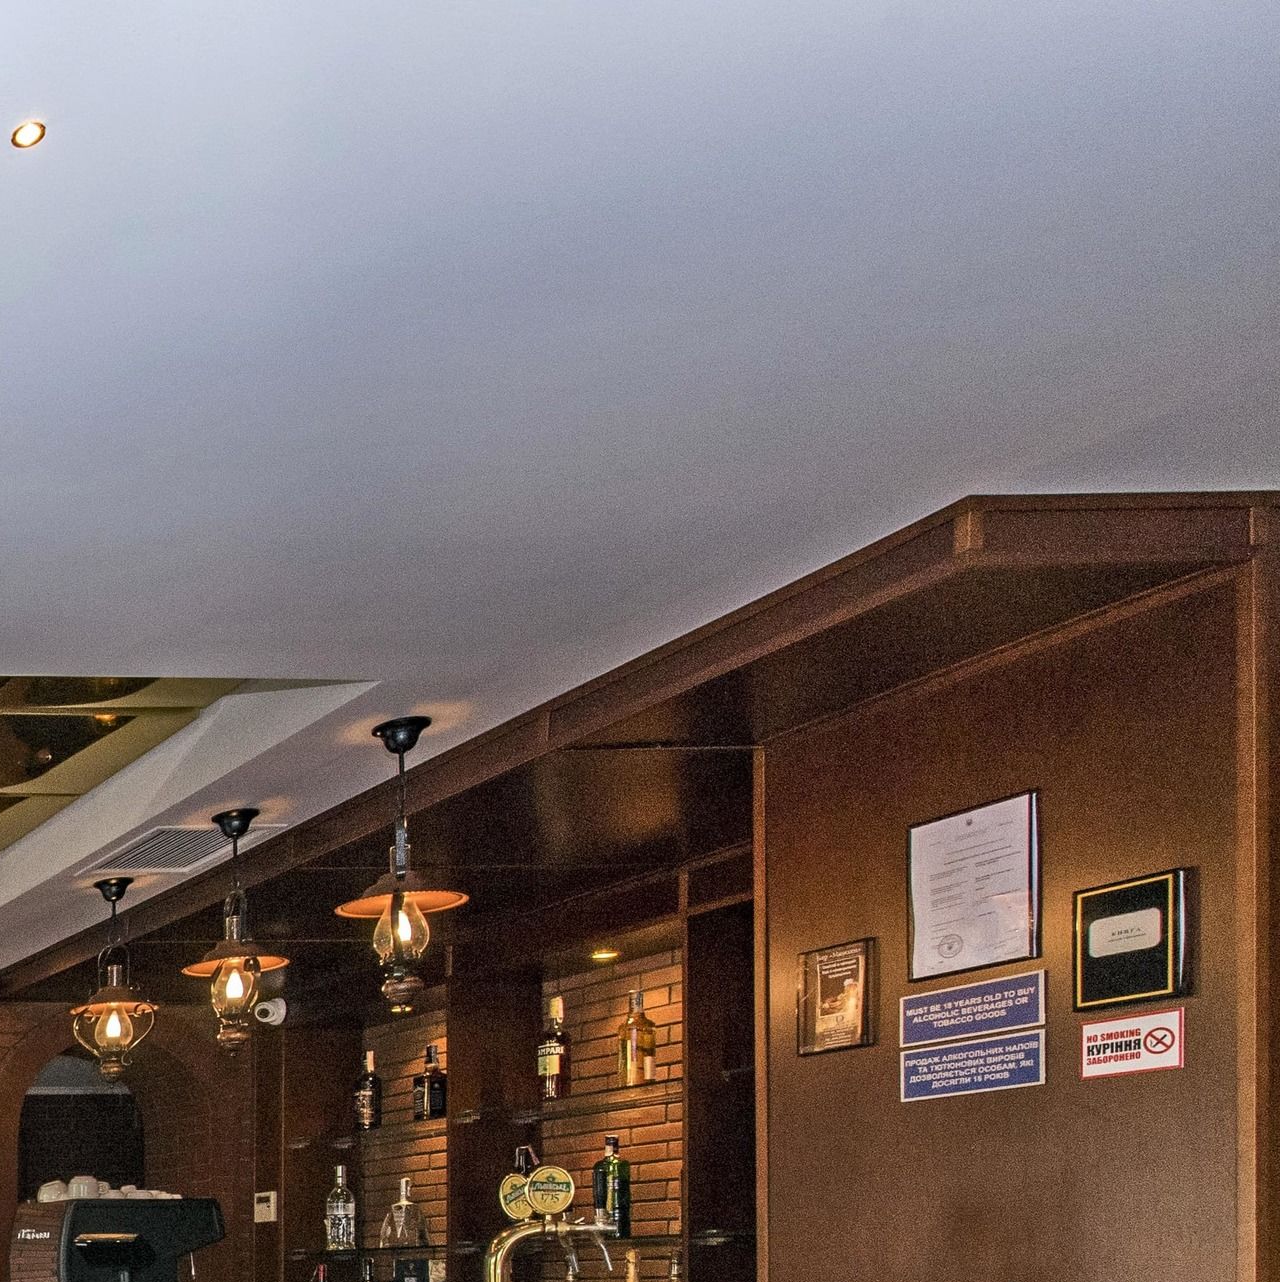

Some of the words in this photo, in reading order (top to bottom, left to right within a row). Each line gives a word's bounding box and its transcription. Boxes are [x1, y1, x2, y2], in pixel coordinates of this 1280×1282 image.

[906, 1006, 928, 1017] MUST
[930, 1004, 941, 1013] BE
[953, 997, 982, 1008] YEARS
[983, 993, 1002, 1003] OLD
[1003, 990, 1016, 999] TO
[1017, 986, 1036, 996] BUY
[912, 1010, 959, 1023] ALCOHOLIC
[961, 1001, 1013, 1015] BEVERAGES
[1015, 996, 1028, 1005] OR
[934, 1015, 973, 1028] TOBACCO
[975, 1009, 1007, 1021] GOODS
[1086, 1034, 1098, 1044] NO
[1100, 1028, 1141, 1041] SMOKING
[537, 1046, 565, 1056] AMPARI
[1086, 1038, 1141, 1056] КУРІННЯ
[905, 1055, 940, 1067] ПРОДАЖ
[942, 1046, 1004, 1062] АЛКОГОЛЬНИХ
[1086, 1051, 1141, 1066] ЗАБОРОНЕНО
[918, 1065, 928, 1073] ТА
